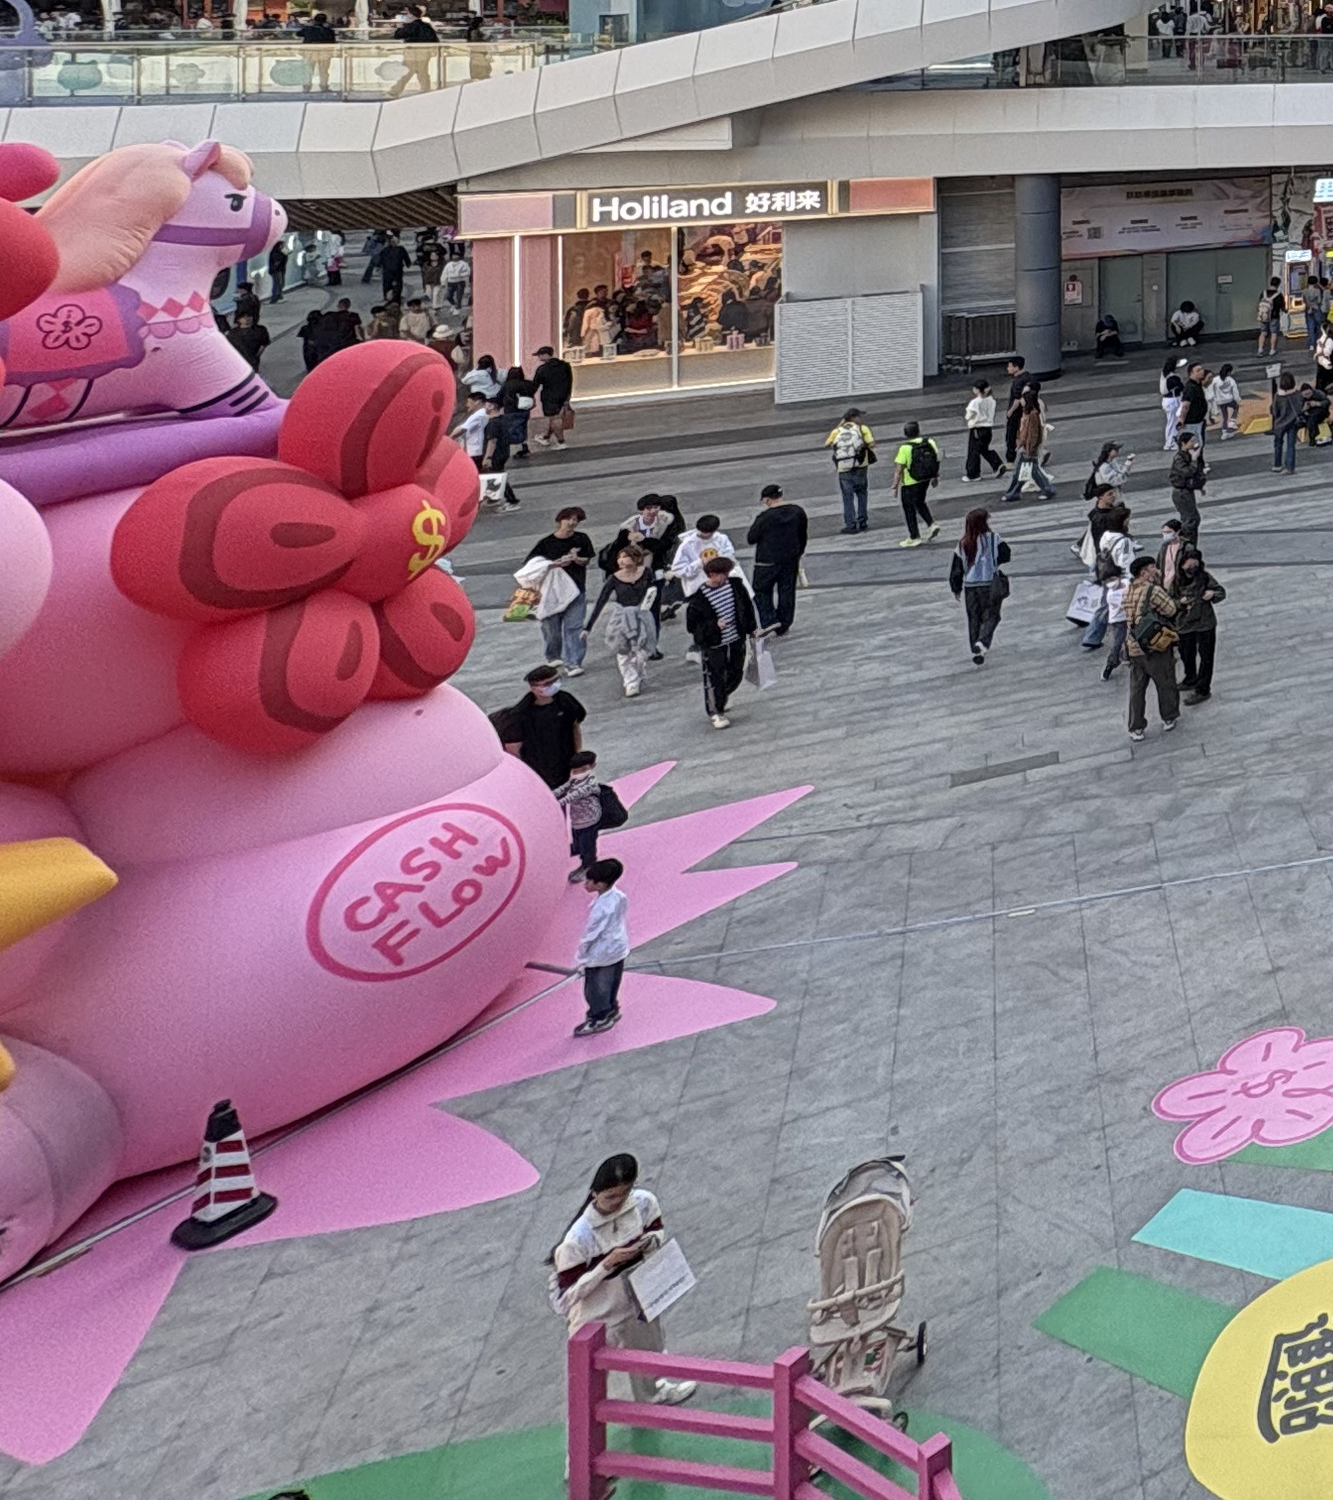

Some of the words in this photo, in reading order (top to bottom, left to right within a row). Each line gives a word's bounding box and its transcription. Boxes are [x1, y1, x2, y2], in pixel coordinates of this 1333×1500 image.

[592, 191, 732, 222] Holiland
[744, 189, 821, 214] 好利来
[343, 821, 479, 933] CASH
[371, 836, 511, 967] FLOW
